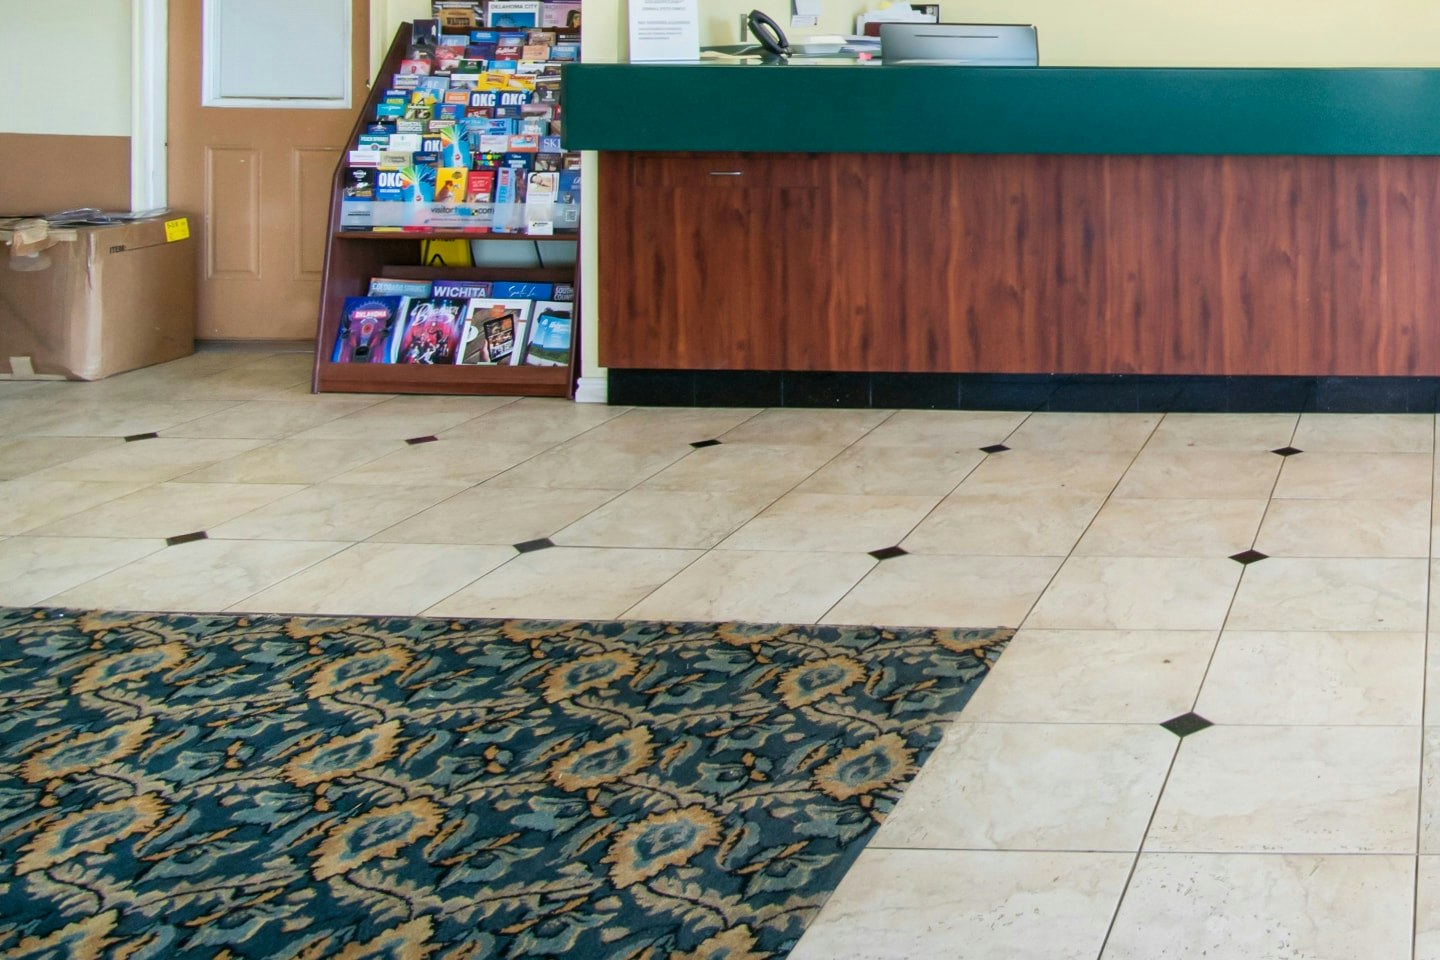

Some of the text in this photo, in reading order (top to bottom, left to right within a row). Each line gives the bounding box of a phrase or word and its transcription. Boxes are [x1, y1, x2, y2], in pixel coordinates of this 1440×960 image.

[472, 92, 496, 107] OKC
[501, 93, 527, 105] OKC
[424, 139, 442, 152] OK
[378, 172, 403, 187] OKC
[433, 285, 487, 299] WICHITA
